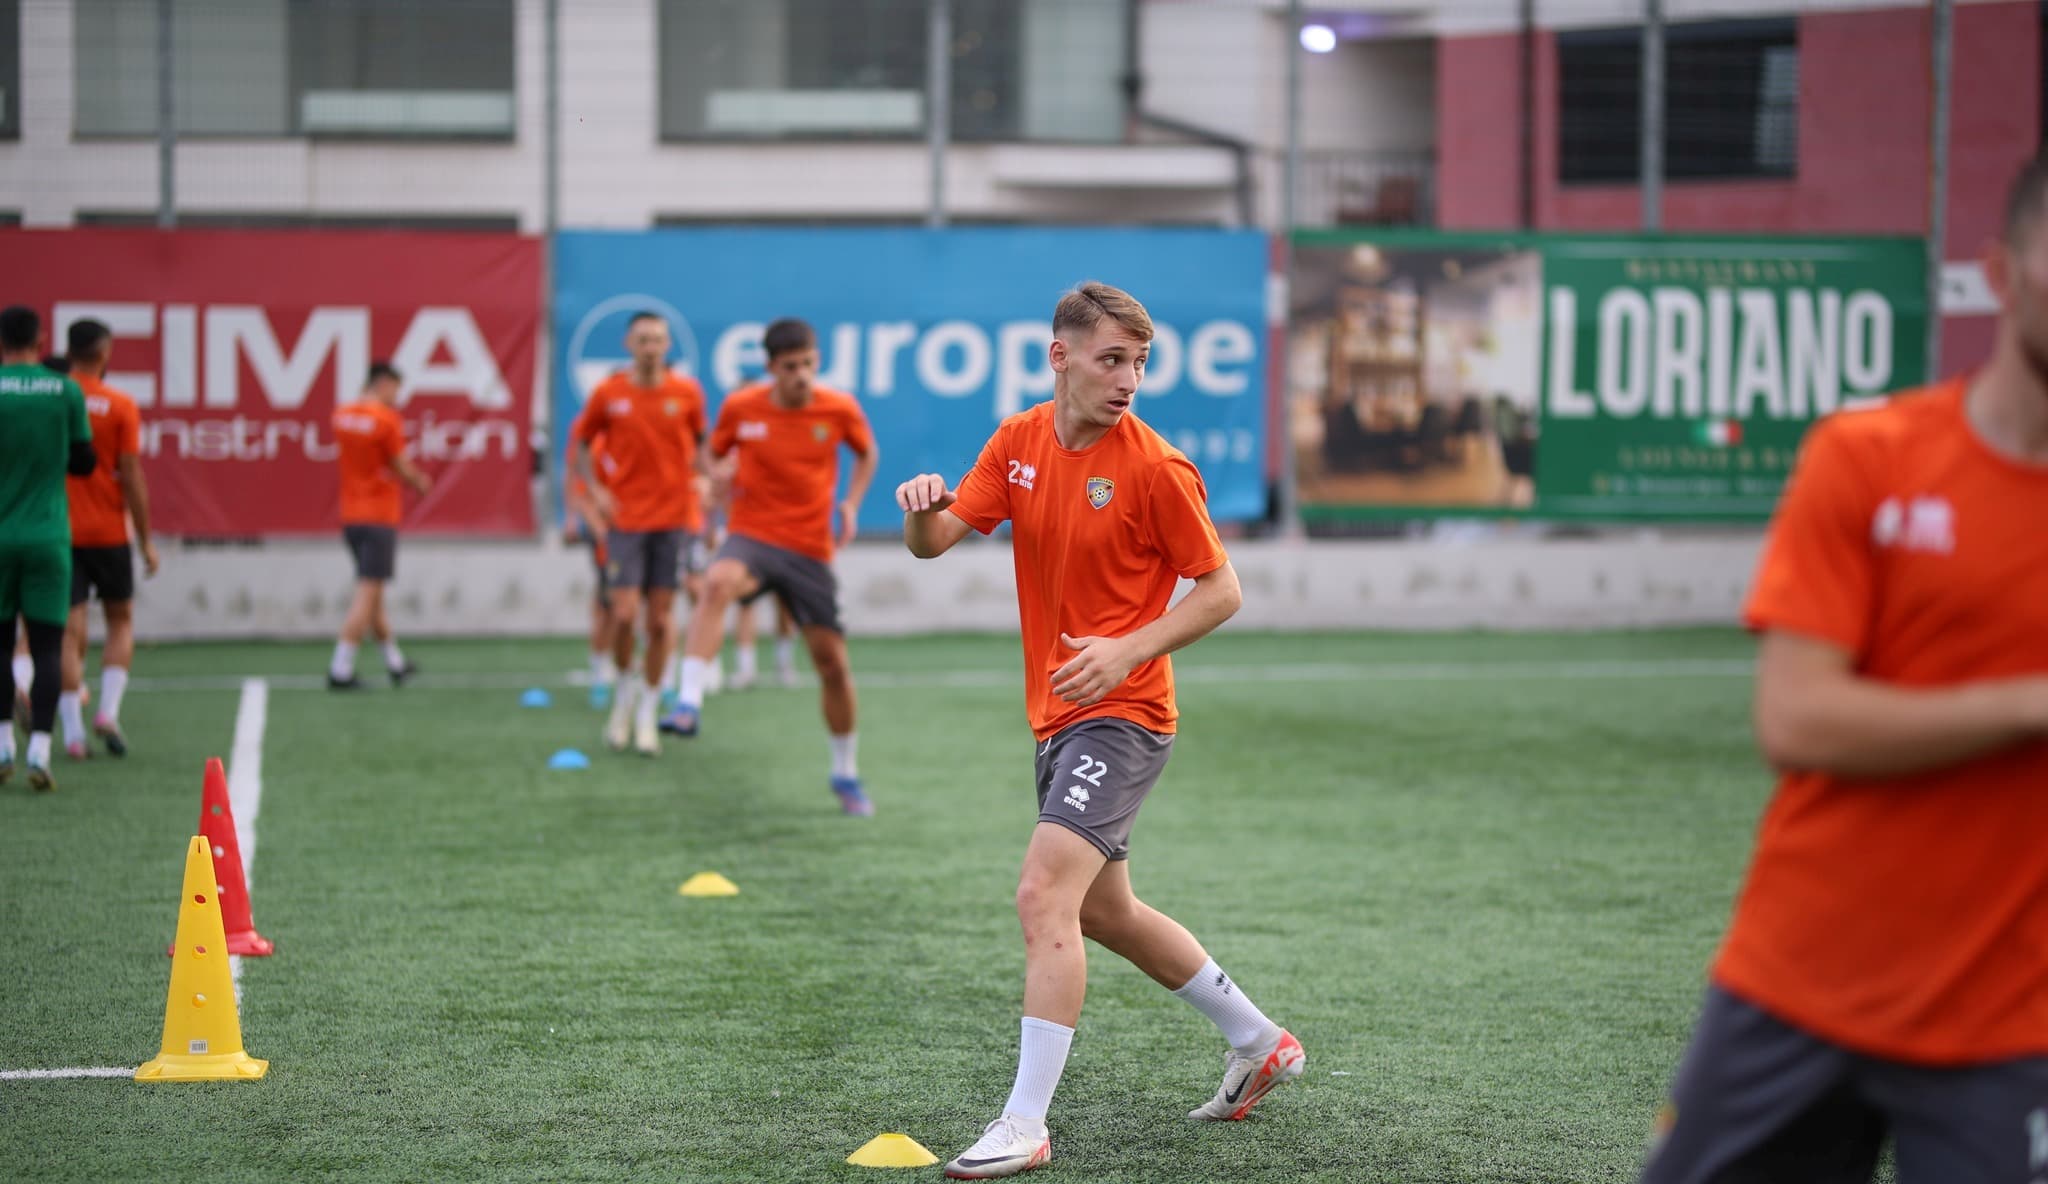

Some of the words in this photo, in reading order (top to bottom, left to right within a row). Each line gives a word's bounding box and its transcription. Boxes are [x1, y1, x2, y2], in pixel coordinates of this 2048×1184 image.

[52, 303, 512, 408] CIMA
[713, 320, 1256, 418] europpe
[1550, 287, 1893, 418] LORIANO
[1071, 754, 1108, 788] 22
